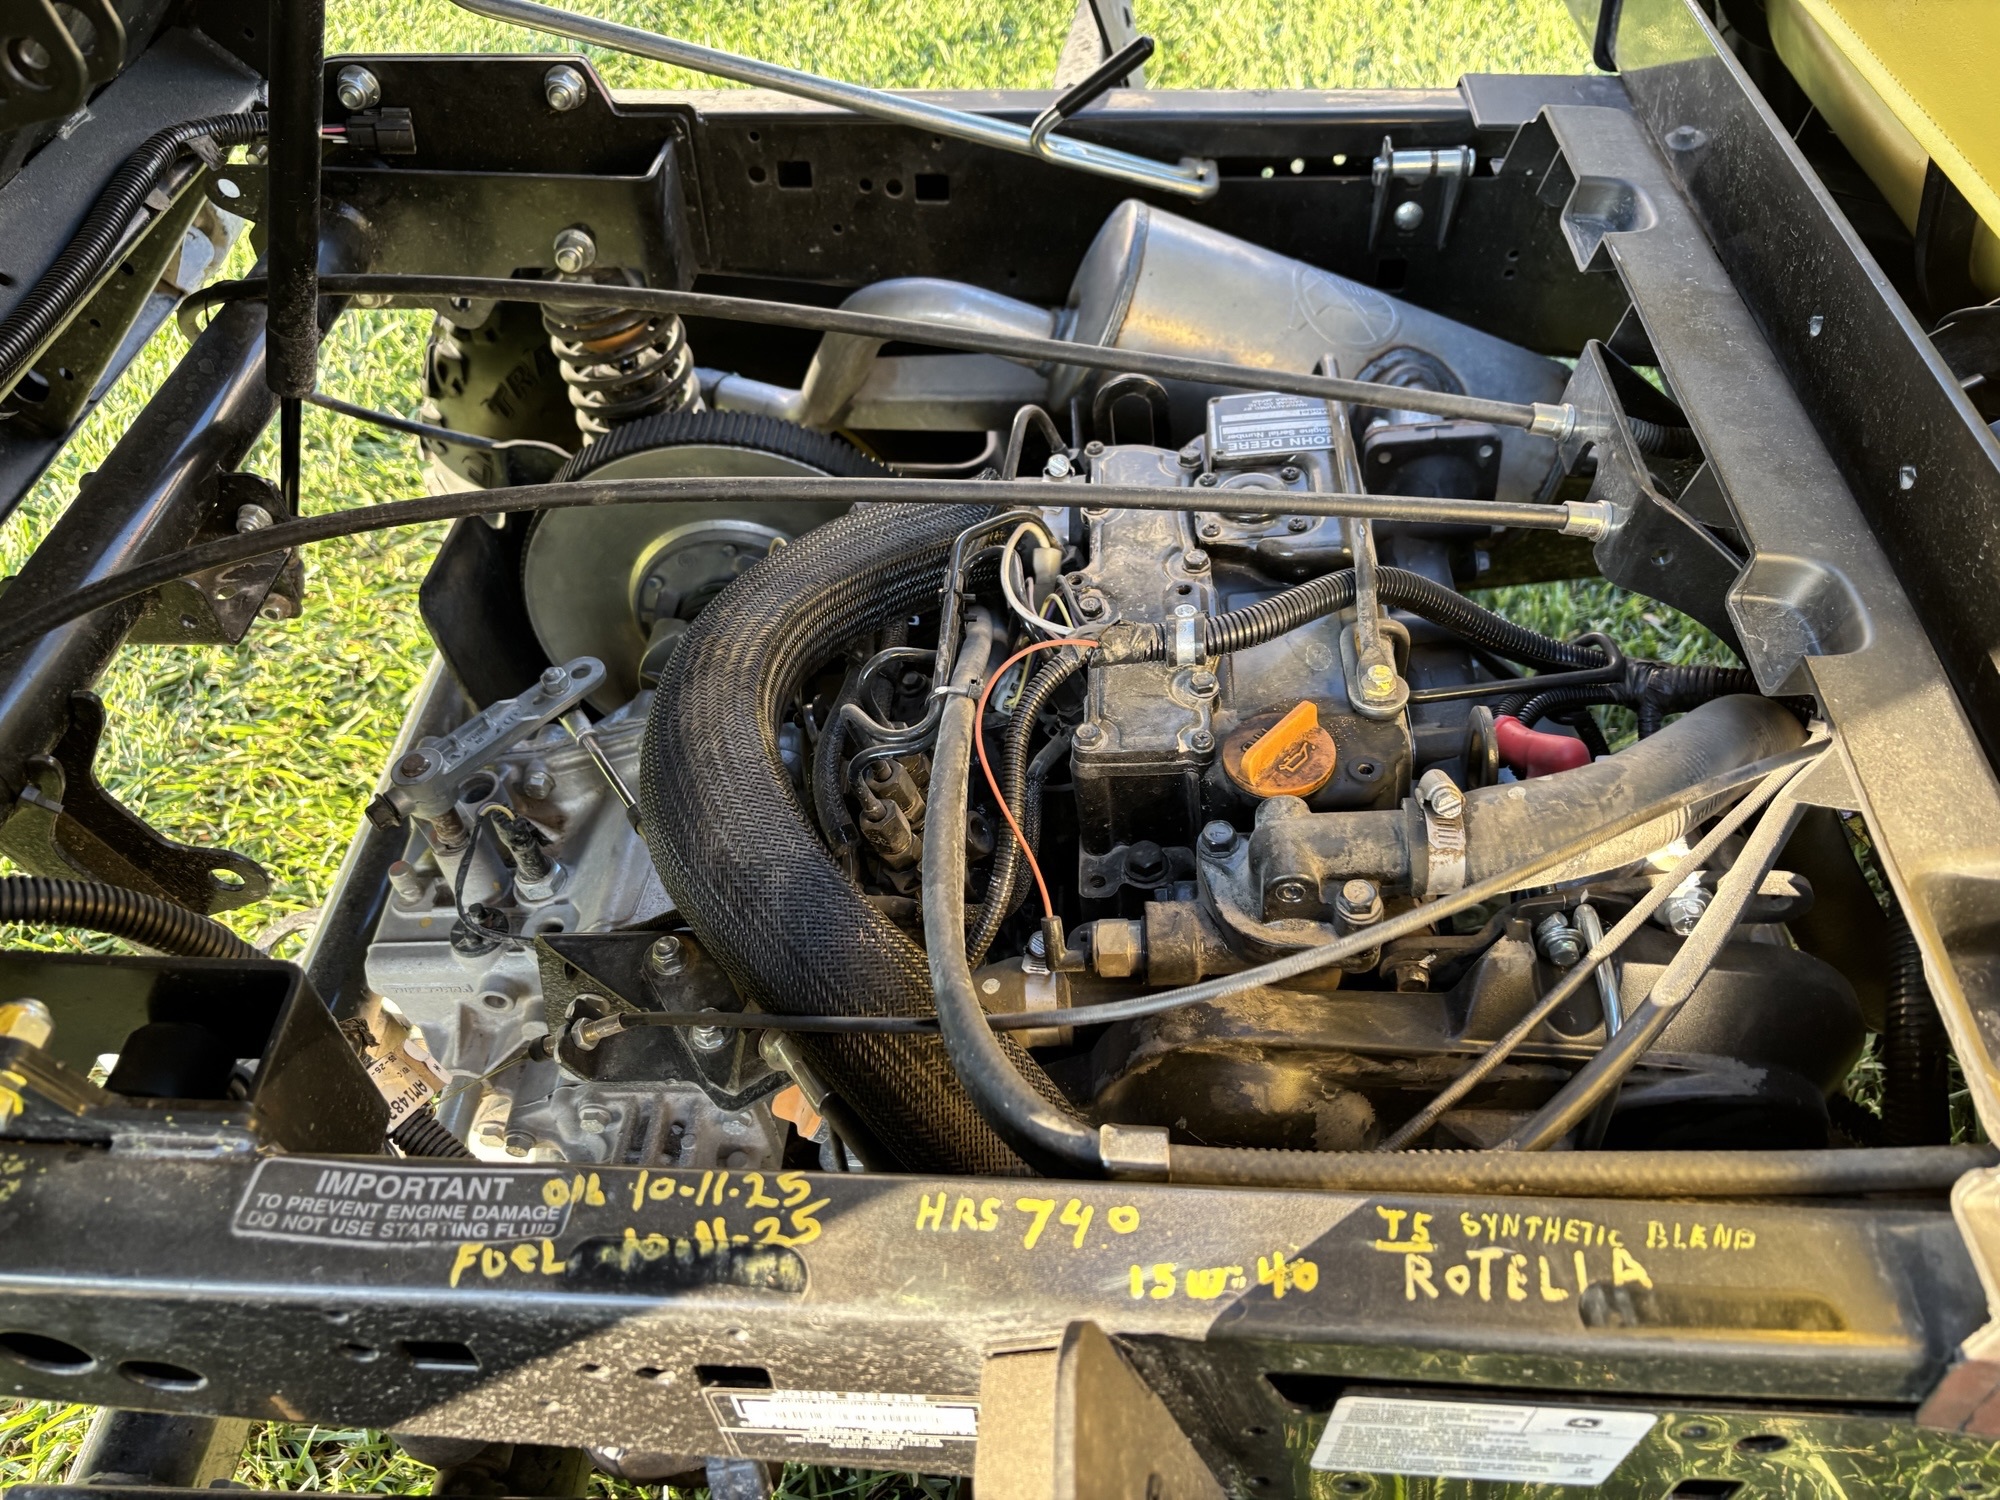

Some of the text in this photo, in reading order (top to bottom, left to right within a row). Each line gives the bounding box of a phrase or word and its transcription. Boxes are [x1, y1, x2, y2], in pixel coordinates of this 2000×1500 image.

[1299, 408, 1329, 416] Model
[1226, 426, 1332, 440] Engine Serial Number
[1228, 436, 1332, 451] JOHN DEERE
[317, 1170, 514, 1201] IMPORTANT
[256, 1192, 560, 1221] TO PREVENT ENGINE DAMAGE
[916, 1192, 1003, 1232] HRS
[246, 1210, 555, 1238] DO NOT USE STARTING FLUID
[1376, 1205, 1757, 1251] T5 SYNTHETIC BLEND
